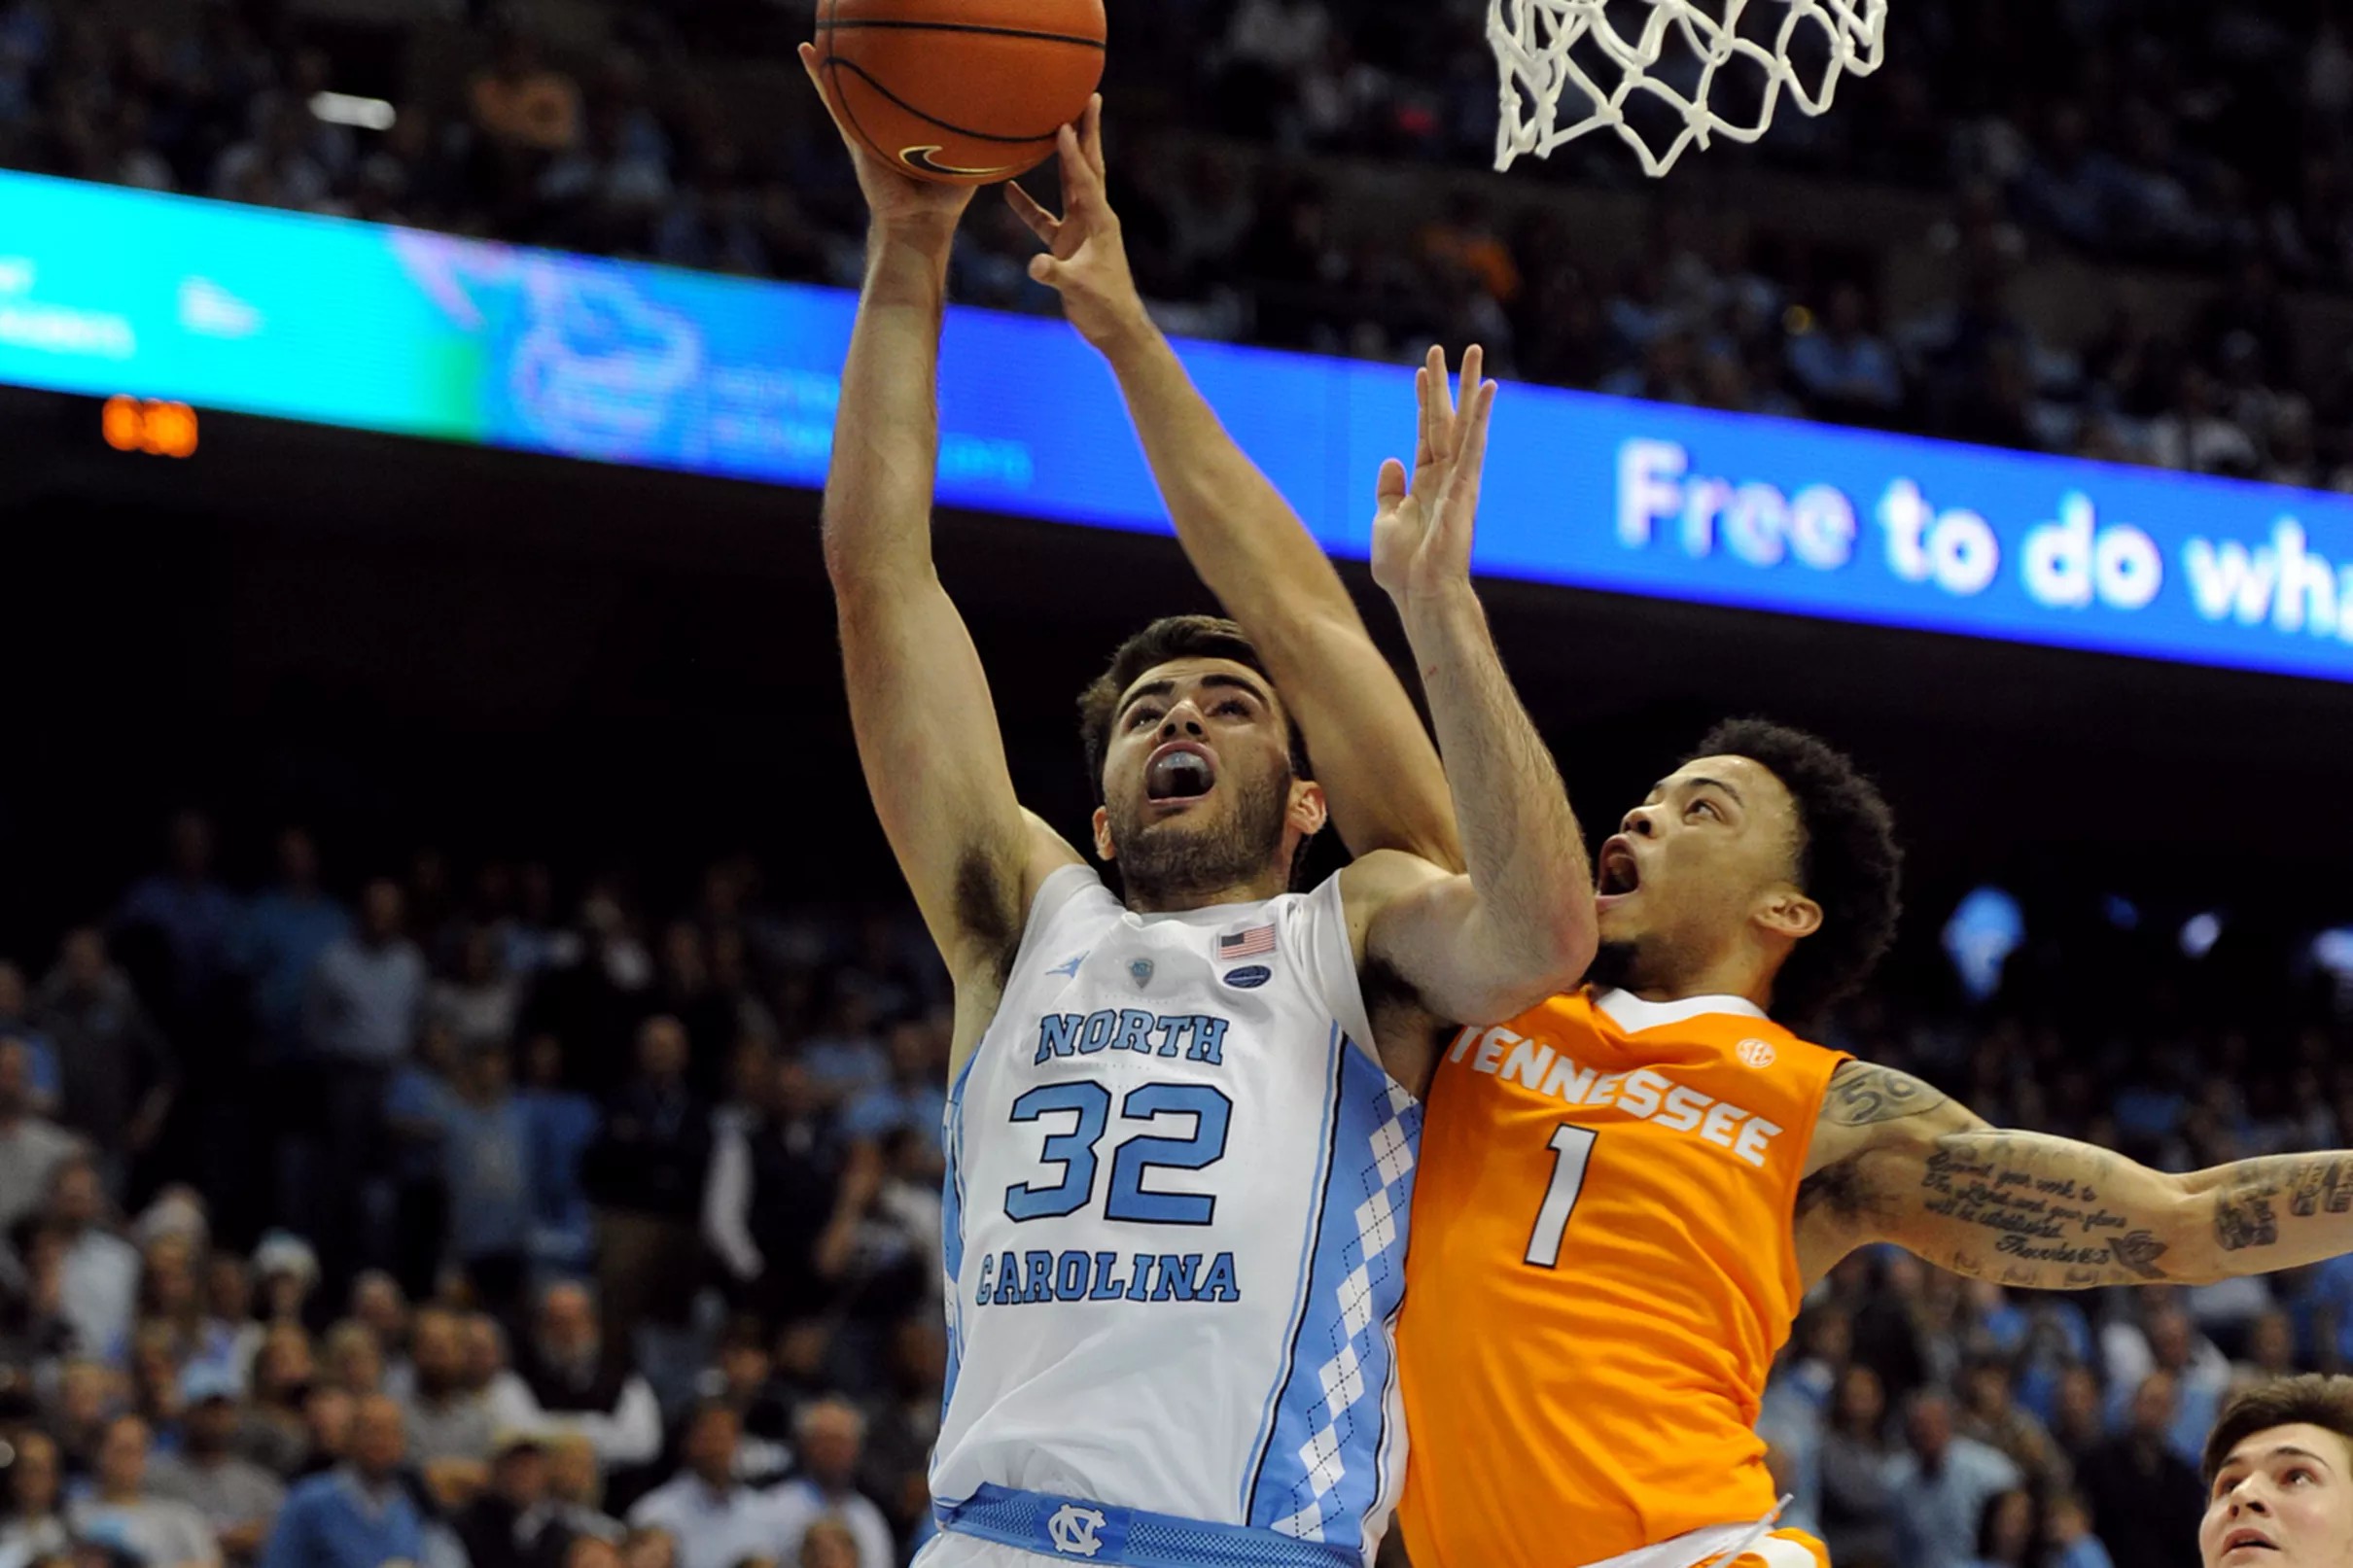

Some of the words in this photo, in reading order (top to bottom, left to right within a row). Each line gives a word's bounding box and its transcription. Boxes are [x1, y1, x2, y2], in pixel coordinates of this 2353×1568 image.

[1615, 436, 1856, 571] Free
[1876, 476, 1999, 595] to
[2020, 488, 2163, 610] do
[1034, 1008, 1229, 1066] NORTH
[1449, 1026, 1784, 1167] TENNESSEE
[1003, 1079, 1233, 1226] 32
[1523, 1122, 1599, 1270] 1
[975, 1250, 1241, 1305] CAROLINA
